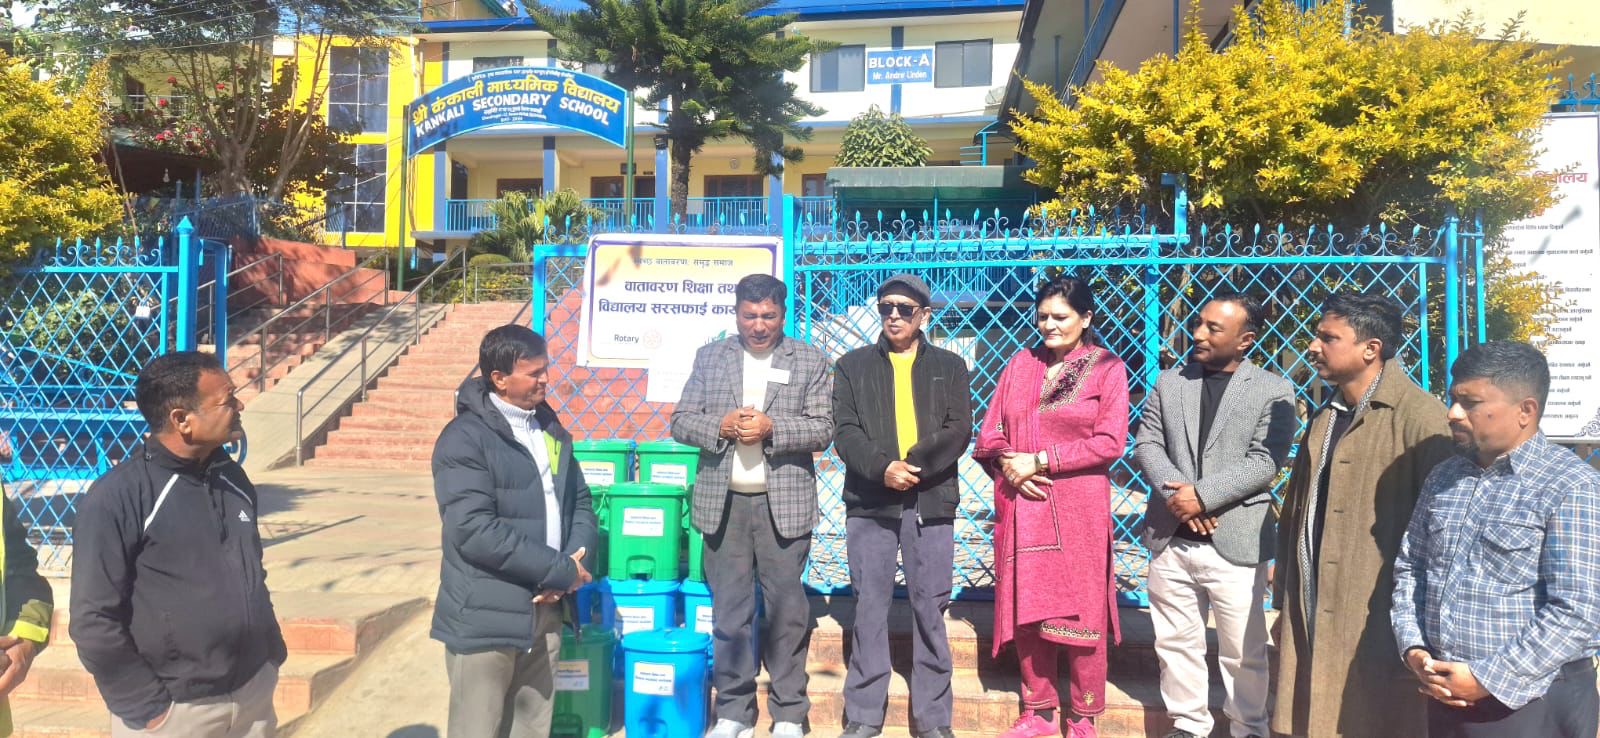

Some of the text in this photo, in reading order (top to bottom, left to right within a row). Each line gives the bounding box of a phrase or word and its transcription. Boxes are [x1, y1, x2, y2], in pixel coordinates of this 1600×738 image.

[412, 103, 428, 126] श्री
[431, 80, 484, 114] कंकाली
[487, 75, 558, 93] माध्यमिक
[563, 78, 621, 114] विद्यालय
[416, 93, 609, 137] KANKALI SECONDARY SCHOOL
[624, 280, 738, 294] वातावरण शिक्षा तथ
[598, 298, 647, 313] विद्यालय
[651, 299, 707, 315] सरसफाई
[614, 334, 640, 344] Rotary
